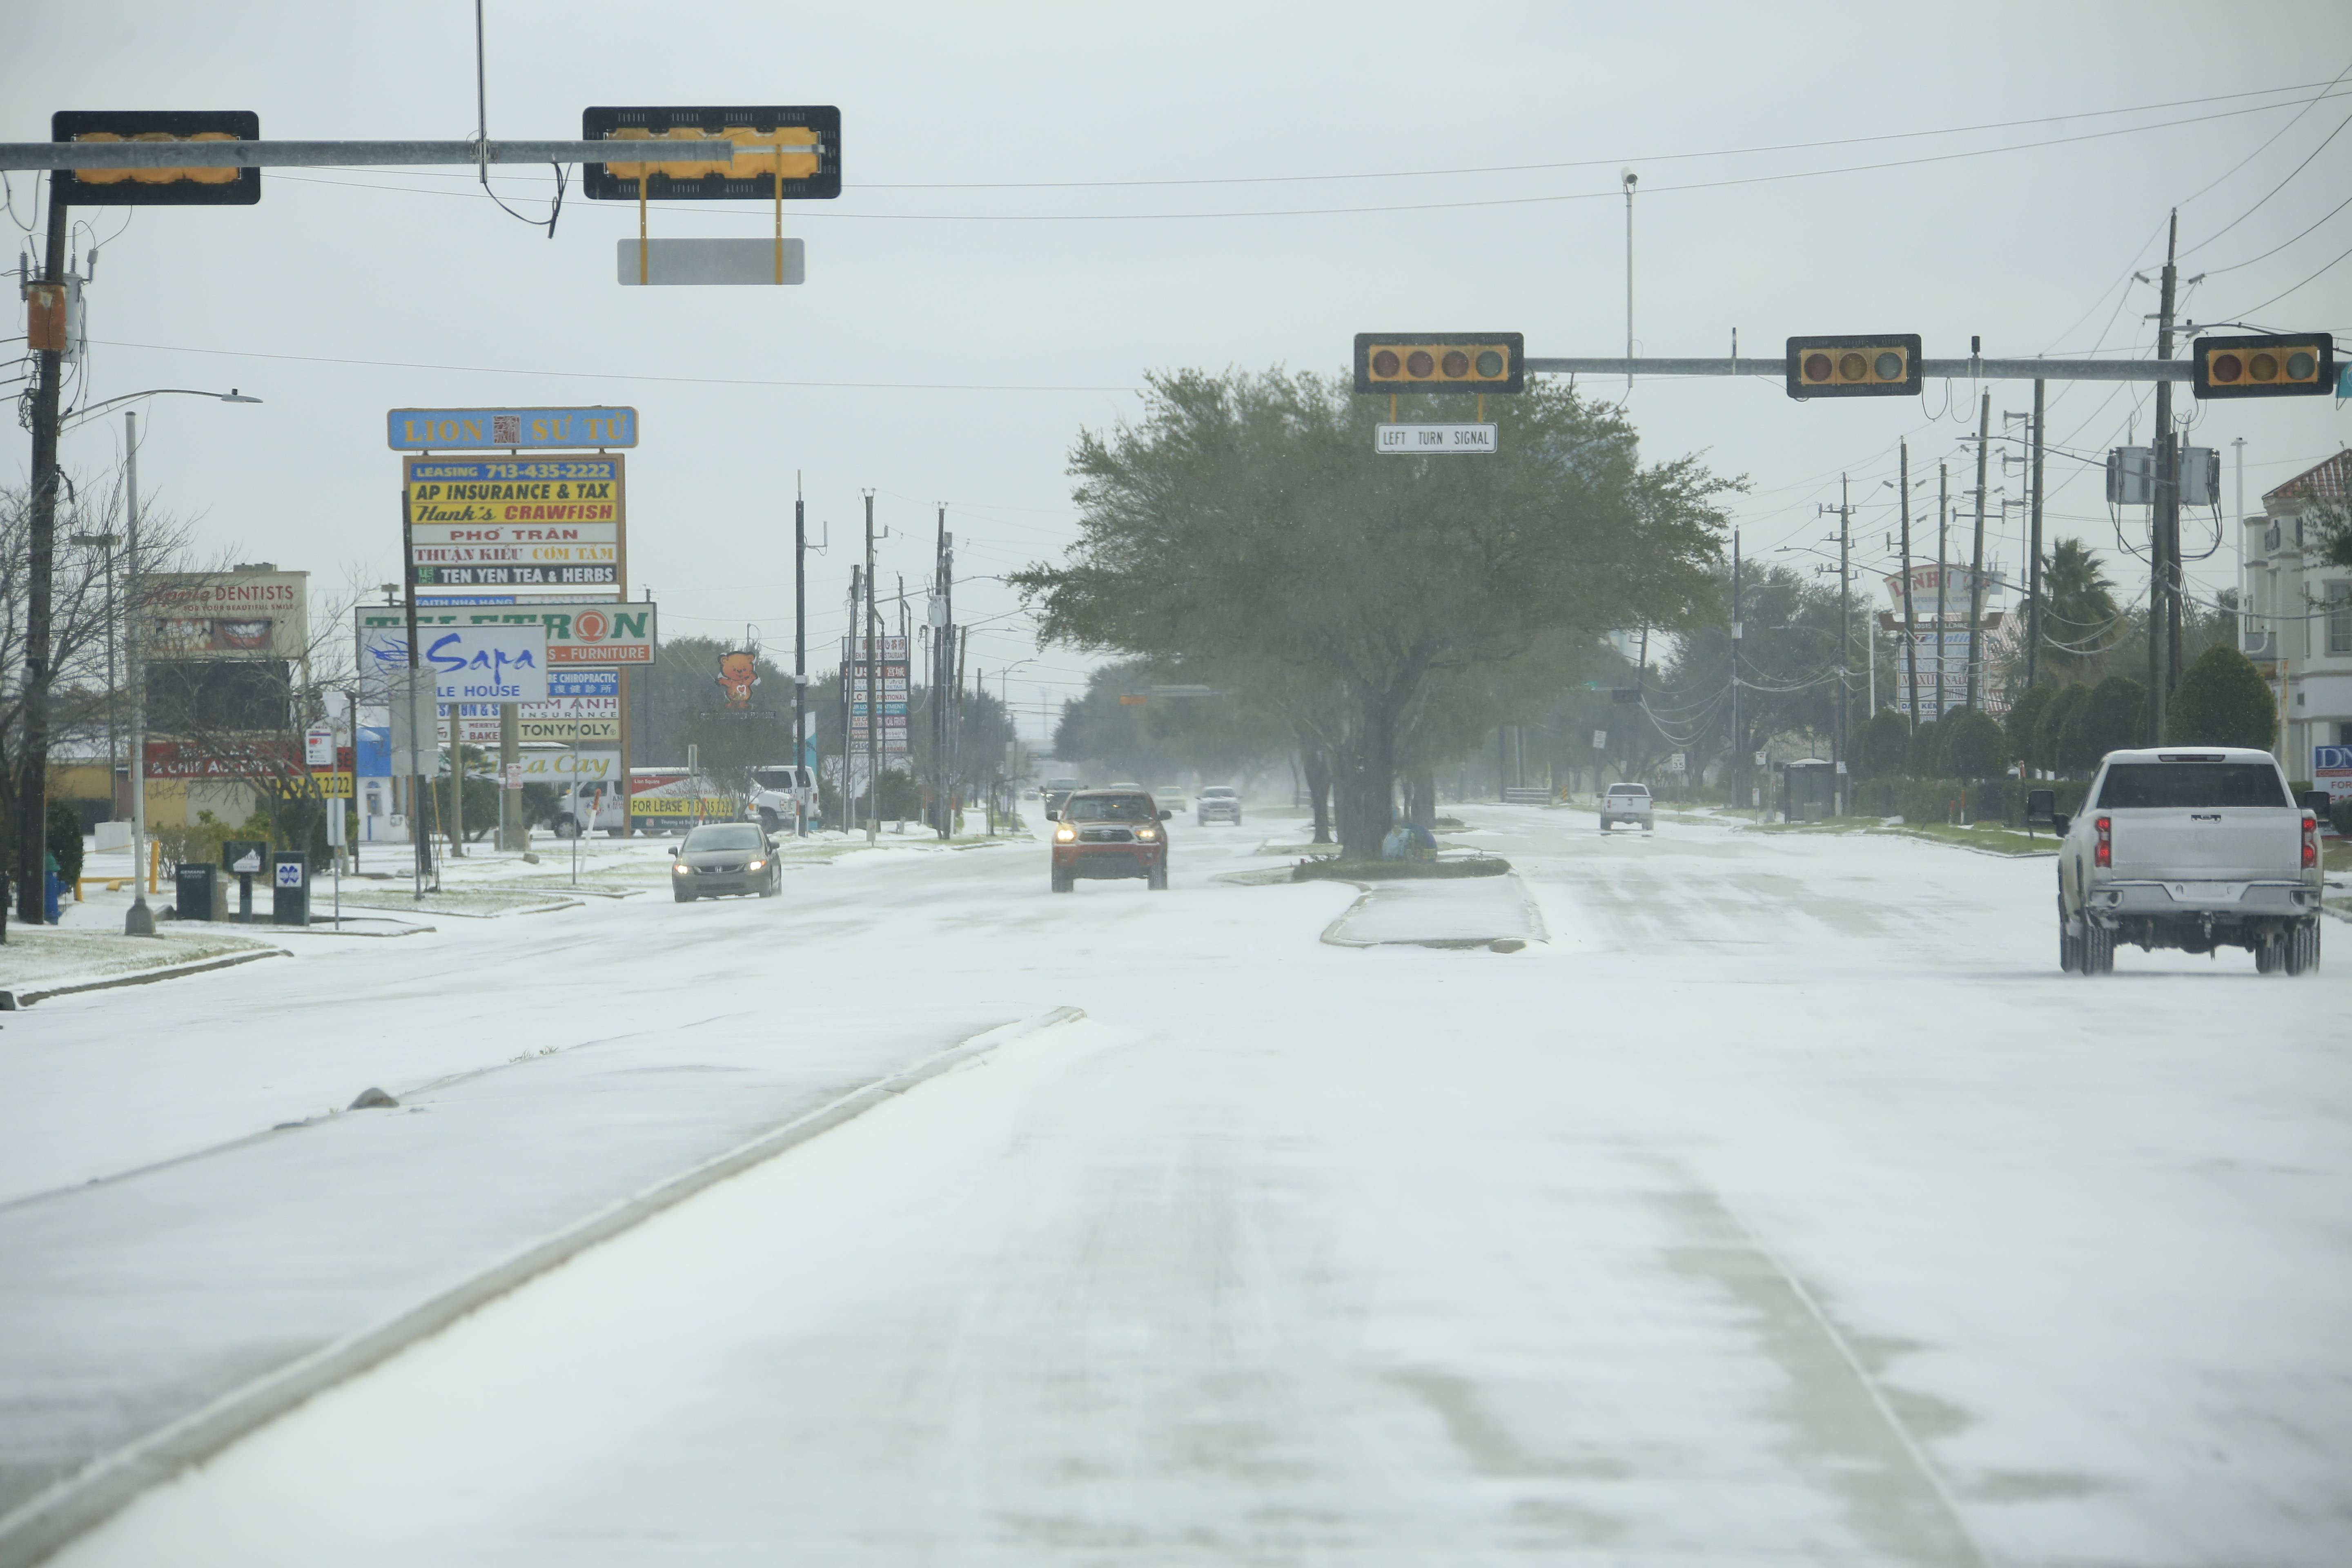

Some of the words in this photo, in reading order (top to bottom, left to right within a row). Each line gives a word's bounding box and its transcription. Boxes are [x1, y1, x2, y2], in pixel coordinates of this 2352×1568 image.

[404, 419, 483, 441] LION
[532, 414, 572, 441] SƯ
[1383, 432, 1406, 445] LEFT
[1419, 432, 1443, 445] TURN
[1455, 431, 1489, 444] SIGNAL
[416, 468, 478, 478] LEASING
[486, 464, 610, 478] 713-435-2222
[416, 485, 440, 500] AP
[447, 483, 553, 500] INSURANCE
[557, 484, 570, 498] &
[577, 483, 610, 498] TAX
[416, 505, 497, 521] Hank's
[505, 505, 613, 520] CRAWFISH
[441, 569, 472, 584] TEN
[477, 569, 508, 583] YEN
[514, 569, 543, 583] TEA
[548, 571, 557, 583] &
[562, 568, 613, 583] HERBS
[216, 586, 294, 601] DENTISTS
[426, 633, 537, 685] Sapa
[572, 647, 645, 659] FURNITURE
[560, 673, 616, 683] CHIROPRACTIC
[464, 686, 520, 697] HOUSE
[570, 698, 617, 709] ANH
[521, 724, 611, 736] TONYMOLY
[554, 754, 610, 781] Cay
[633, 800, 651, 812] FOR
[654, 800, 683, 812] LEASE
